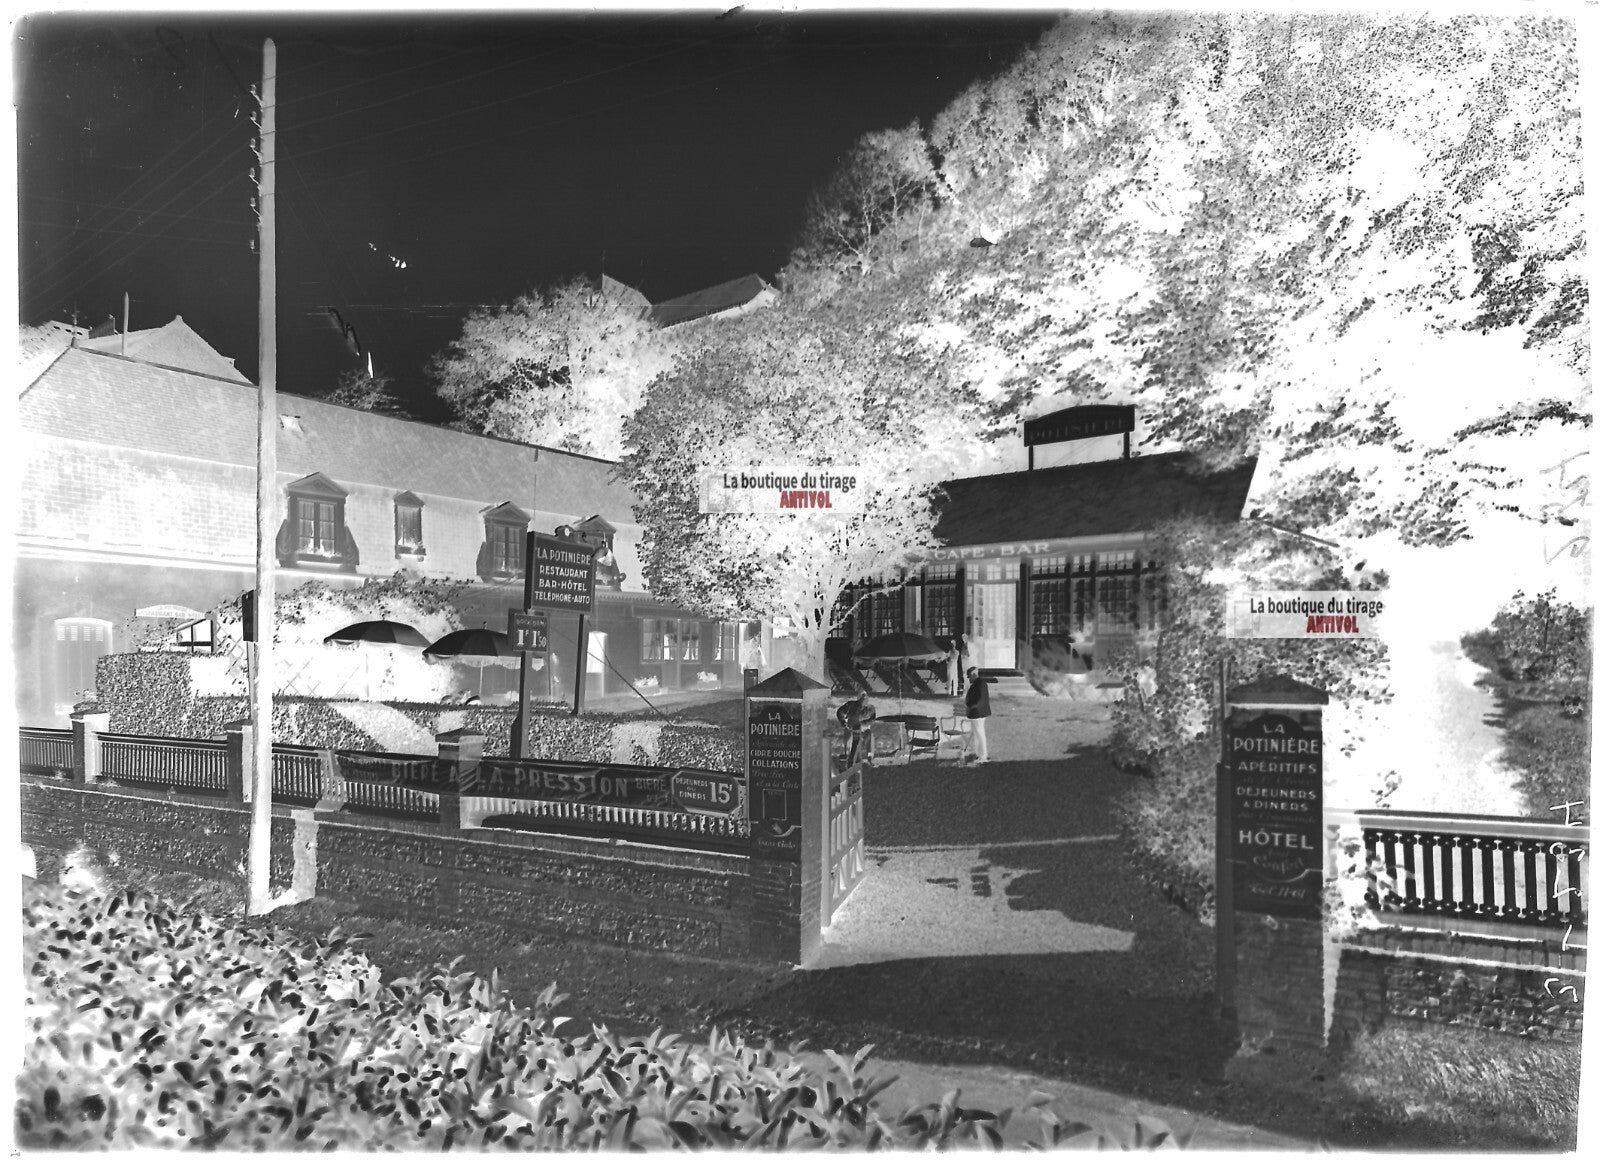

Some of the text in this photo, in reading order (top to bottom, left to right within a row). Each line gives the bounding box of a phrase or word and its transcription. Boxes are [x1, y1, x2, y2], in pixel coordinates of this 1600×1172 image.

[537, 548, 548, 559] LA
[1001, 542, 1049, 556] BAR
[539, 565, 588, 579] RESTAURANT
[768, 713, 781, 721] LA
[1263, 723, 1285, 734] LA
[750, 749, 772, 757] CIDRE
[752, 758, 799, 769] COLLATIONS
[514, 767, 628, 797] PRESSION
[1239, 828, 1314, 850] HÔTEL
